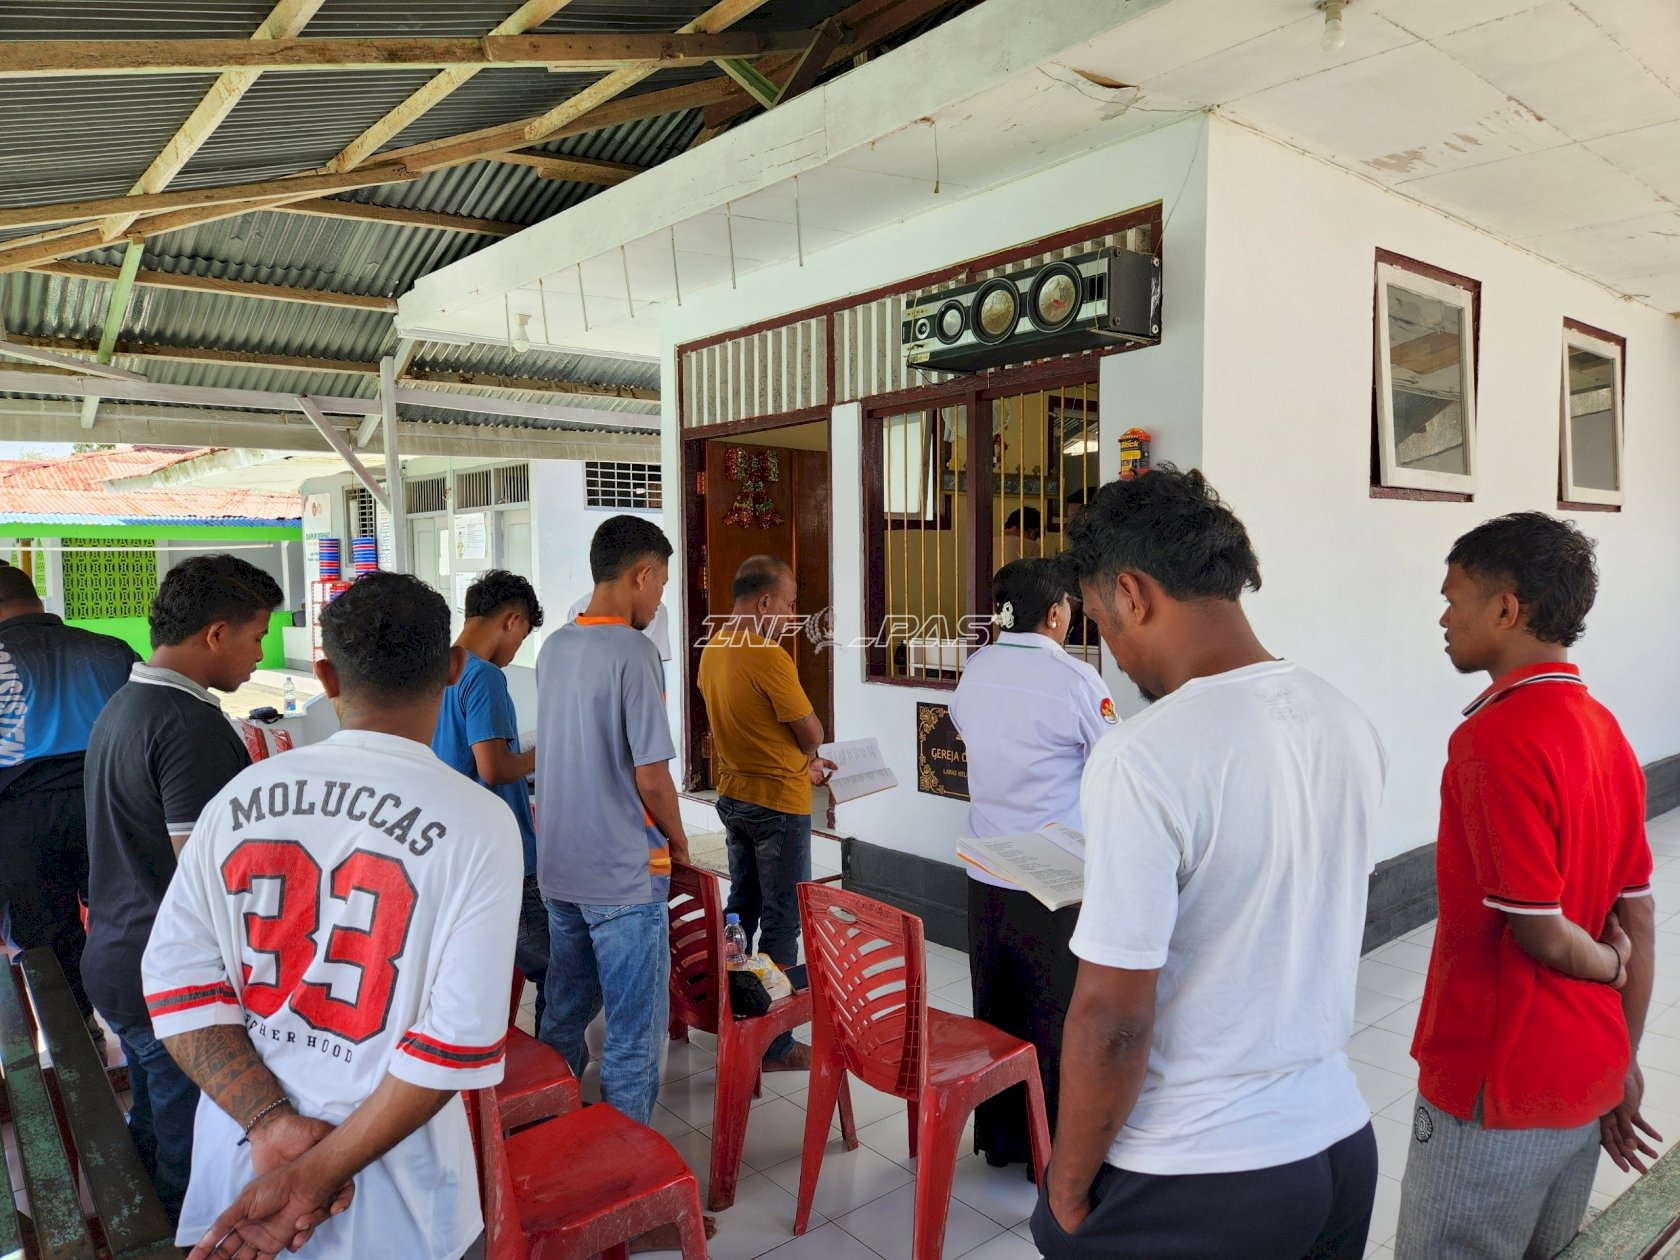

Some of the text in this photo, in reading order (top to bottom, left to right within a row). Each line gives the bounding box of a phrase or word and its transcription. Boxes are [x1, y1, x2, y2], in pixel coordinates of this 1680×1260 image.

[931, 747, 960, 763] GEREJA
[229, 779, 447, 857] MOLUCCAS
[220, 838, 420, 1046] 33
